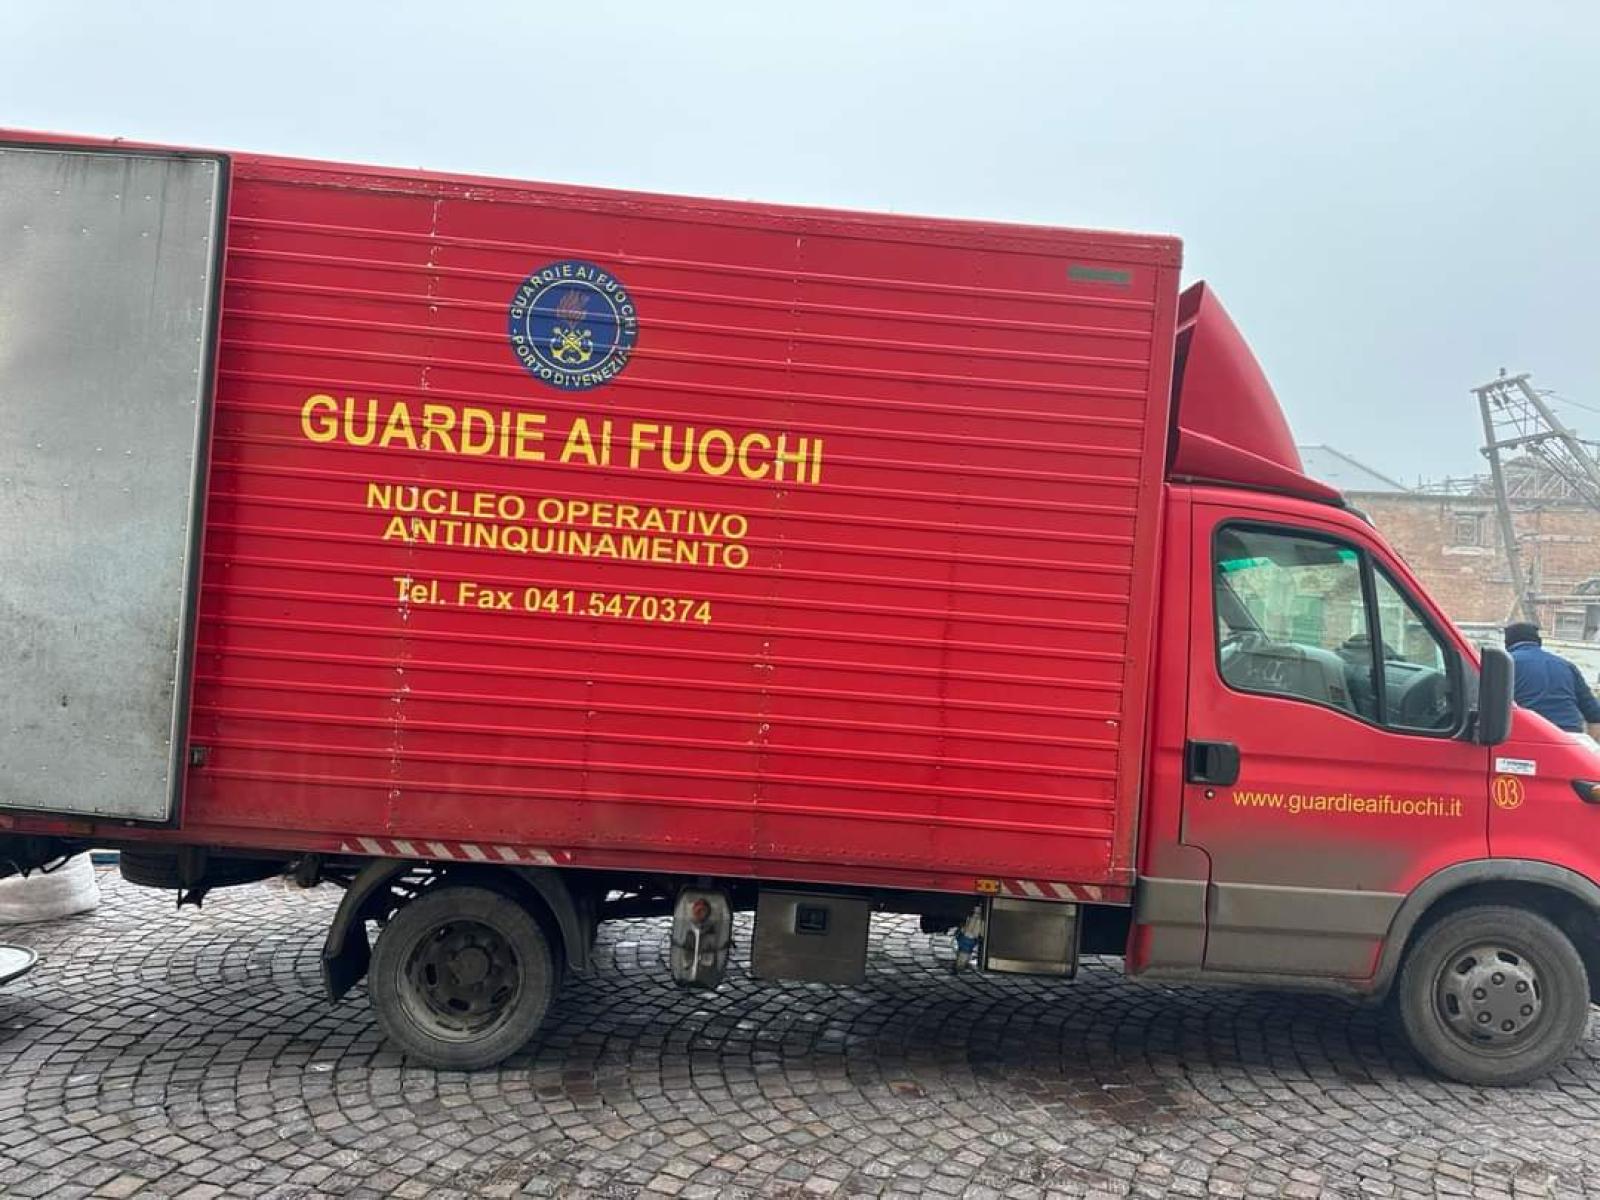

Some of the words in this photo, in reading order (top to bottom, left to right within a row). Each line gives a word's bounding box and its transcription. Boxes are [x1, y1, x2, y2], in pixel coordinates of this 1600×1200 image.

[510, 264, 572, 319] GUARDIE
[576, 266, 594, 280] AI
[597, 273, 637, 335] FUOCHI
[300, 394, 546, 463] GUARDIE
[559, 417, 612, 466] AI
[628, 423, 824, 485] FUOCHI
[366, 483, 525, 521] NUCLEO
[536, 498, 749, 539] OPERATIVO
[381, 515, 750, 570] ANTINQUINAMENTO
[393, 576, 446, 606] Tel.
[459, 582, 513, 611] Fax
[524, 587, 712, 625] 041.5470374
[1232, 789, 1464, 817] www.guardieaifuochi.it
[1497, 778, 1518, 806] 03
